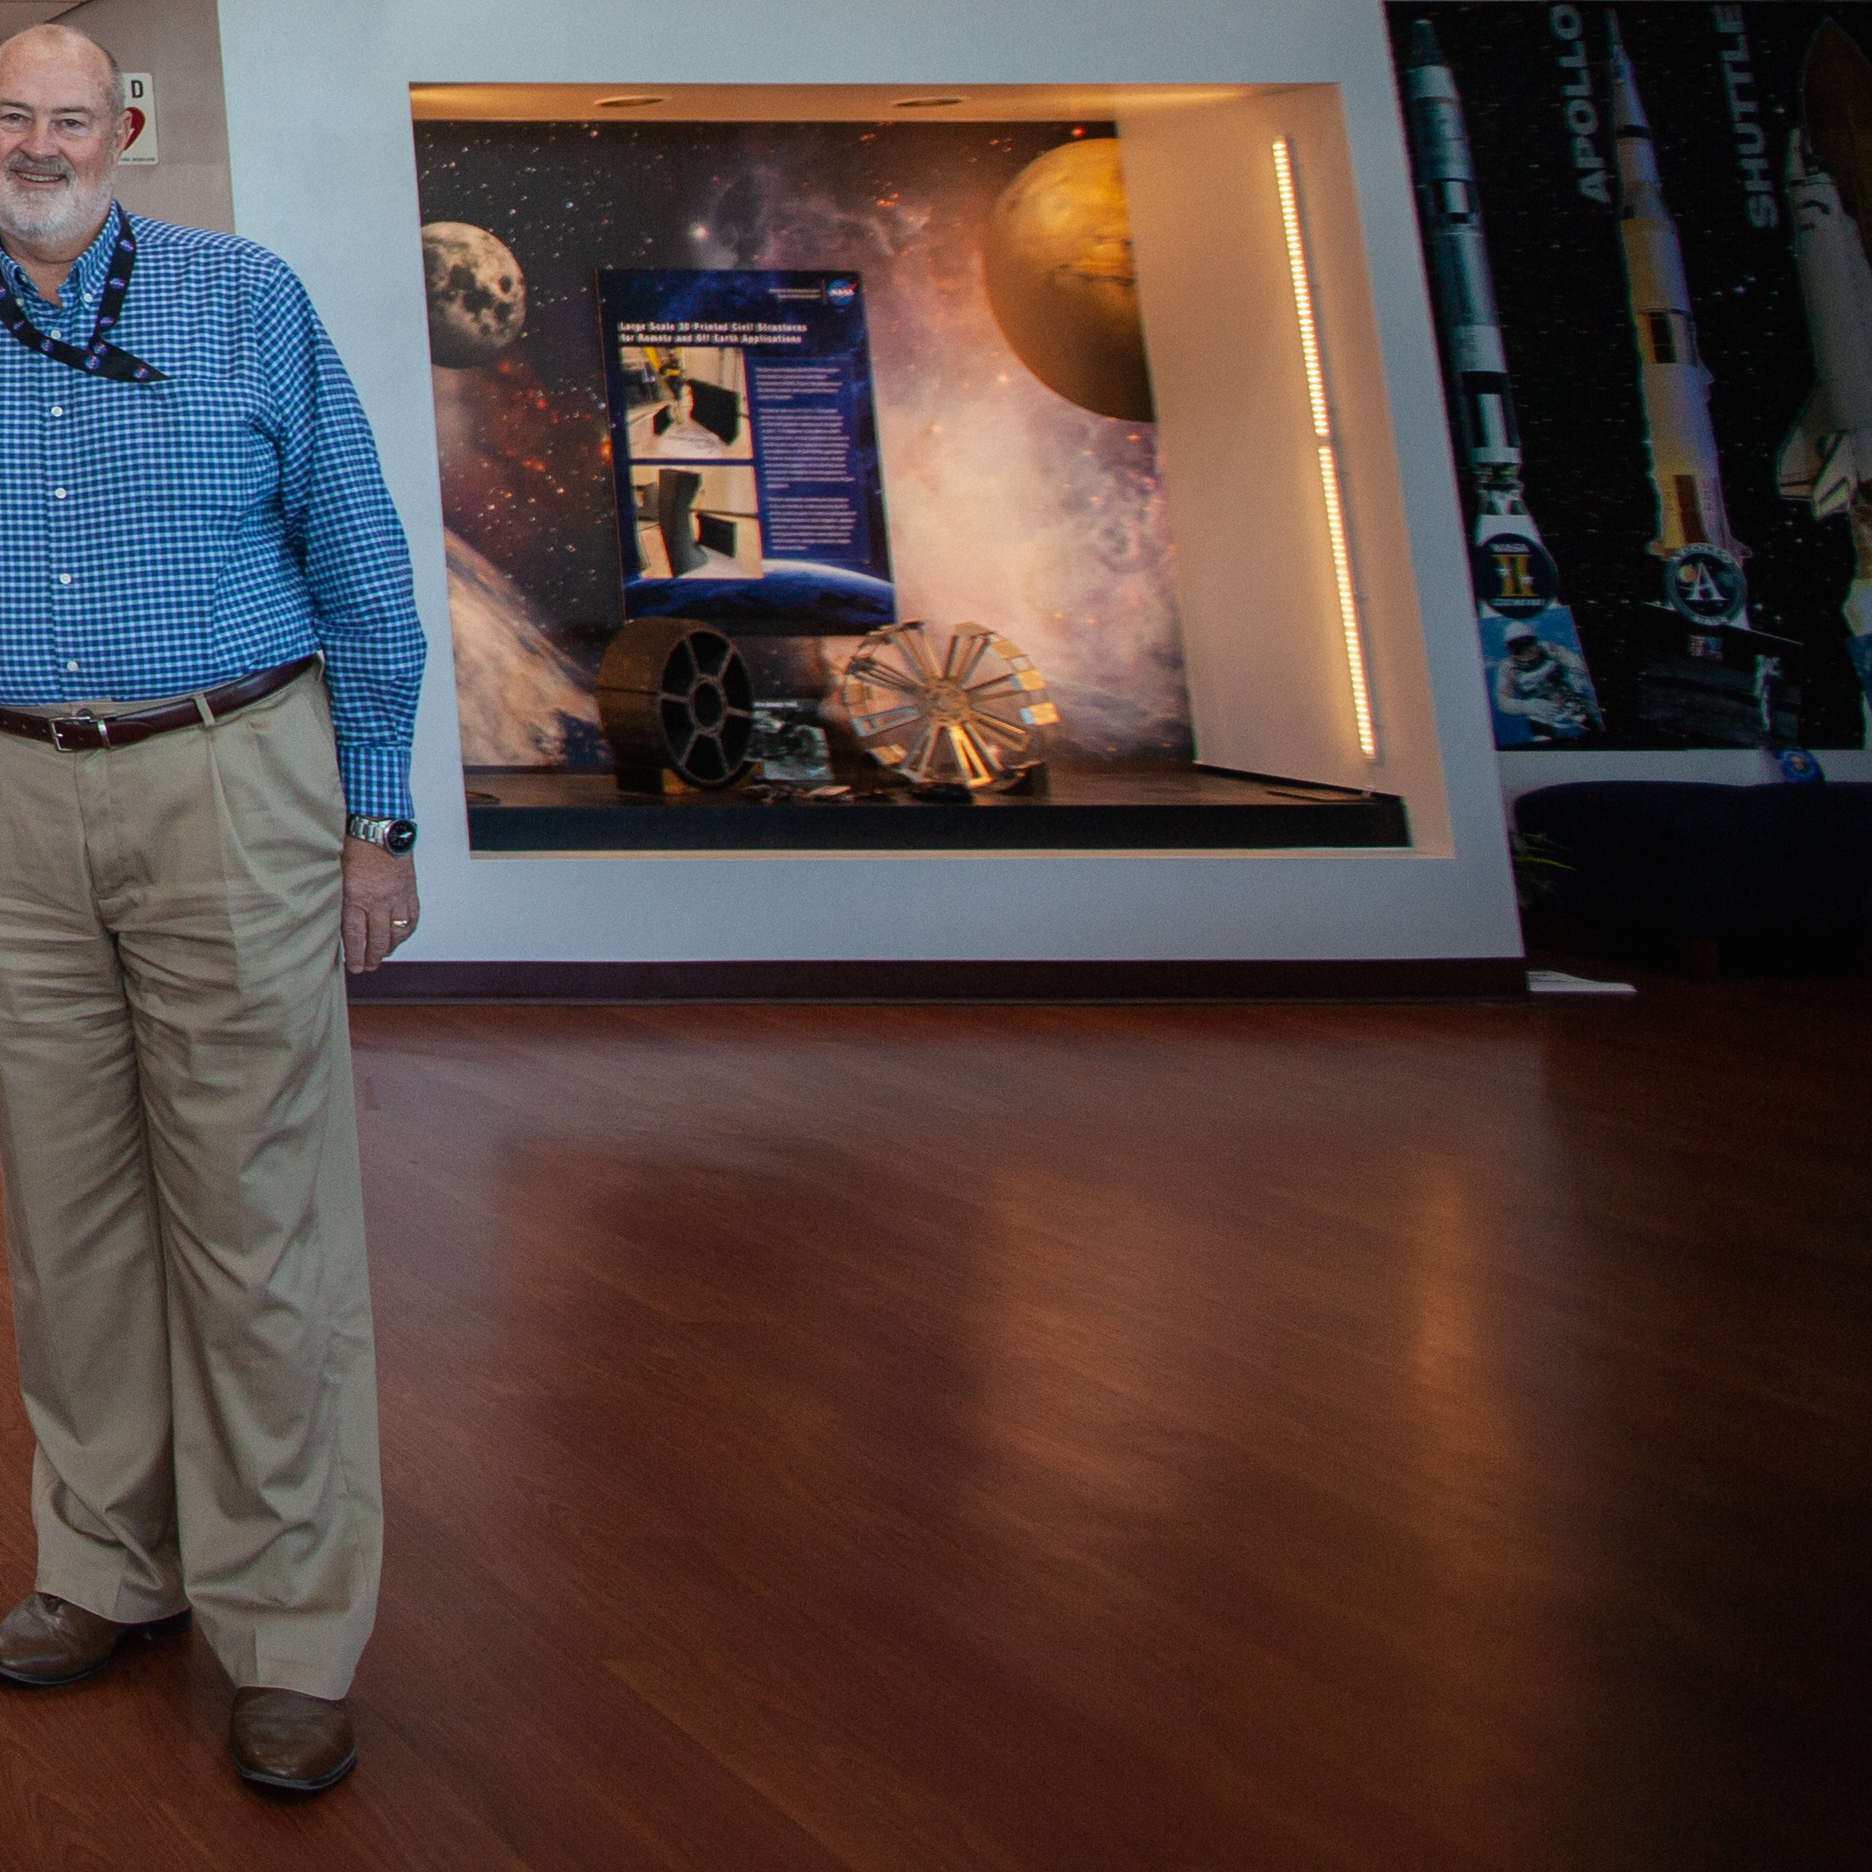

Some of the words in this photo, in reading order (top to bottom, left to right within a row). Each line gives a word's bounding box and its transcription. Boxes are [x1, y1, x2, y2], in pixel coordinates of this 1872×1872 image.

[1549, 4, 1612, 204] APOLLO
[1711, 4, 1779, 228] SHUTTLE
[619, 321, 646, 332] Large
[648, 322, 675, 331] Scale
[693, 322, 729, 331] Printed
[731, 322, 754, 331] Civil
[756, 322, 808, 332] Structures
[636, 334, 672, 343] Remote
[674, 334, 693, 343] and
[712, 334, 739, 343] Earth
[742, 334, 802, 345] Applications
